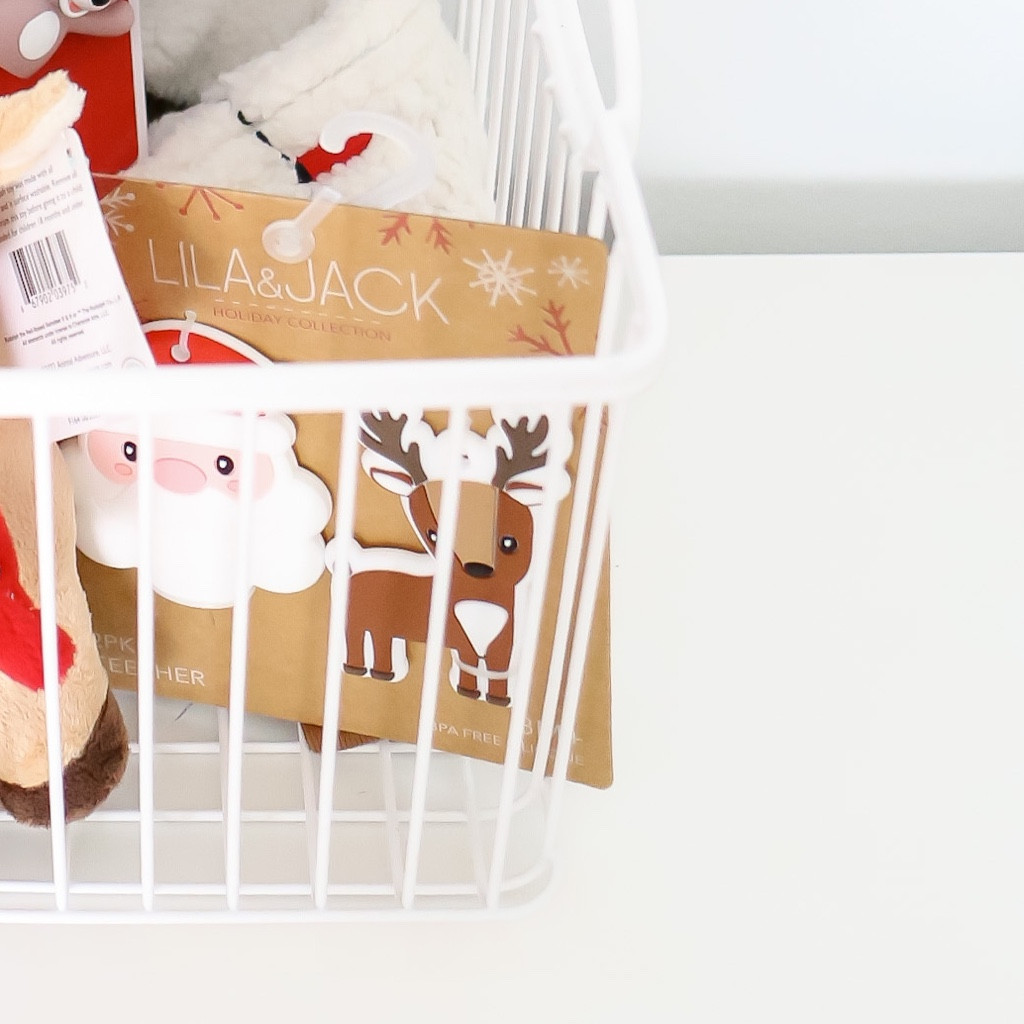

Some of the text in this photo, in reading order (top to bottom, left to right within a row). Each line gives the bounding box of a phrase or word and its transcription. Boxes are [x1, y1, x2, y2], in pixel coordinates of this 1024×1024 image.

[148, 238, 450, 325] LILA&JACK
[212, 307, 391, 342] HOLIDAY COLLECTION
[462, 728, 502, 746] FREE
